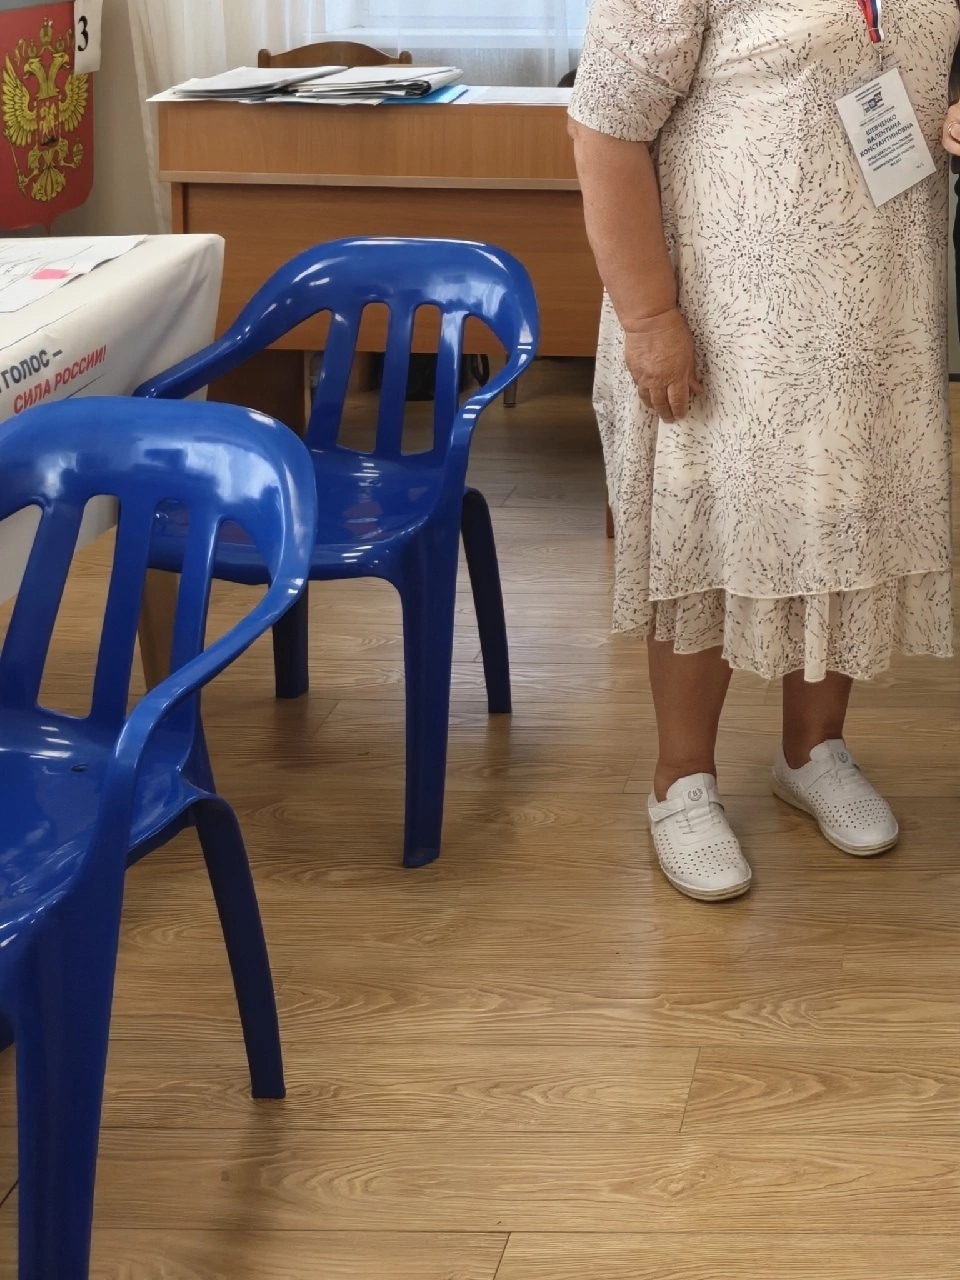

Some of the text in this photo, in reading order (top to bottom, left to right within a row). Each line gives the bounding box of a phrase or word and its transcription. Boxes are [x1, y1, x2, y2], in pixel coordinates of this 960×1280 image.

[77, 15, 89, 52] 3
[860, 122, 914, 157] КОНСТАНТИНОВНА
[865, 114, 897, 136] ШЕВЧЕНКО
[866, 121, 901, 144] ВАЛЕНТИНА
[0, 349, 50, 389] ГОЛОС
[13, 344, 107, 415] СИЛА РОССИИ!
